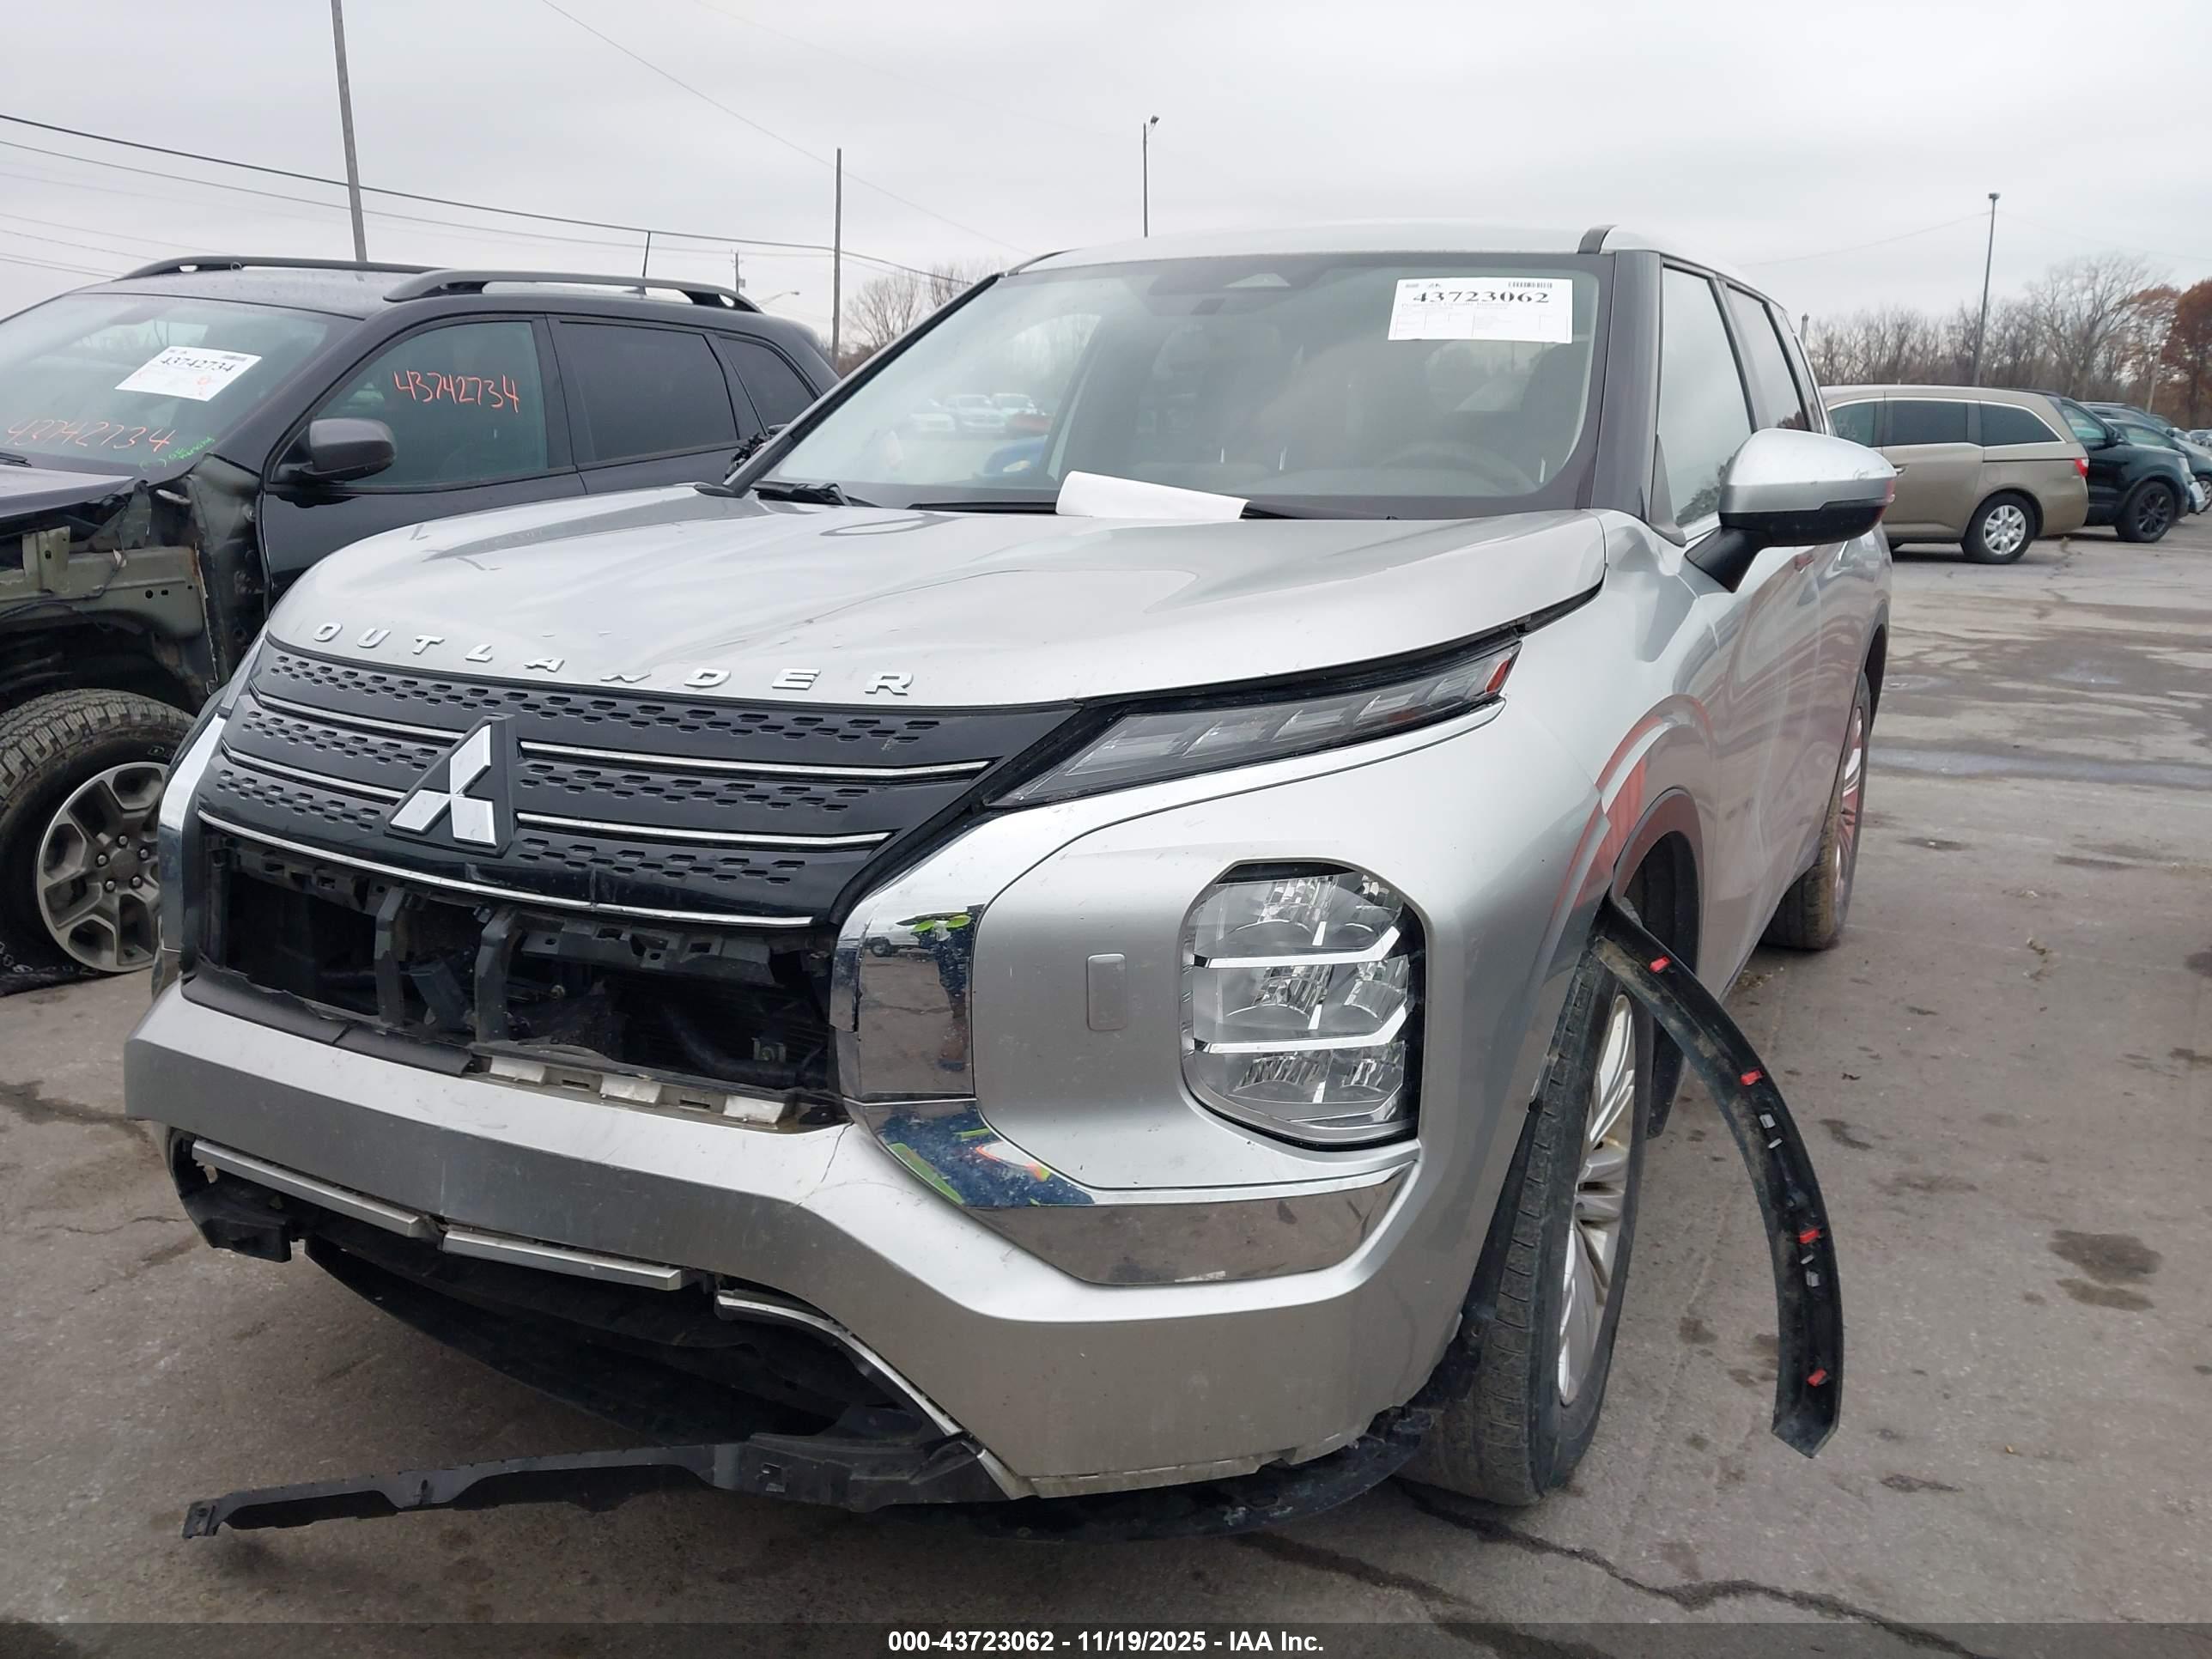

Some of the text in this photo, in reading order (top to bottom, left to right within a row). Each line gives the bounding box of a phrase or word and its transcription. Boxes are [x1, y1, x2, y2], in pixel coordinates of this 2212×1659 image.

[1413, 290, 1550, 303] 43723062
[393, 369, 520, 413] 43742734
[4, 419, 176, 453] 43742734
[313, 622, 915, 696] OUTLANDER
